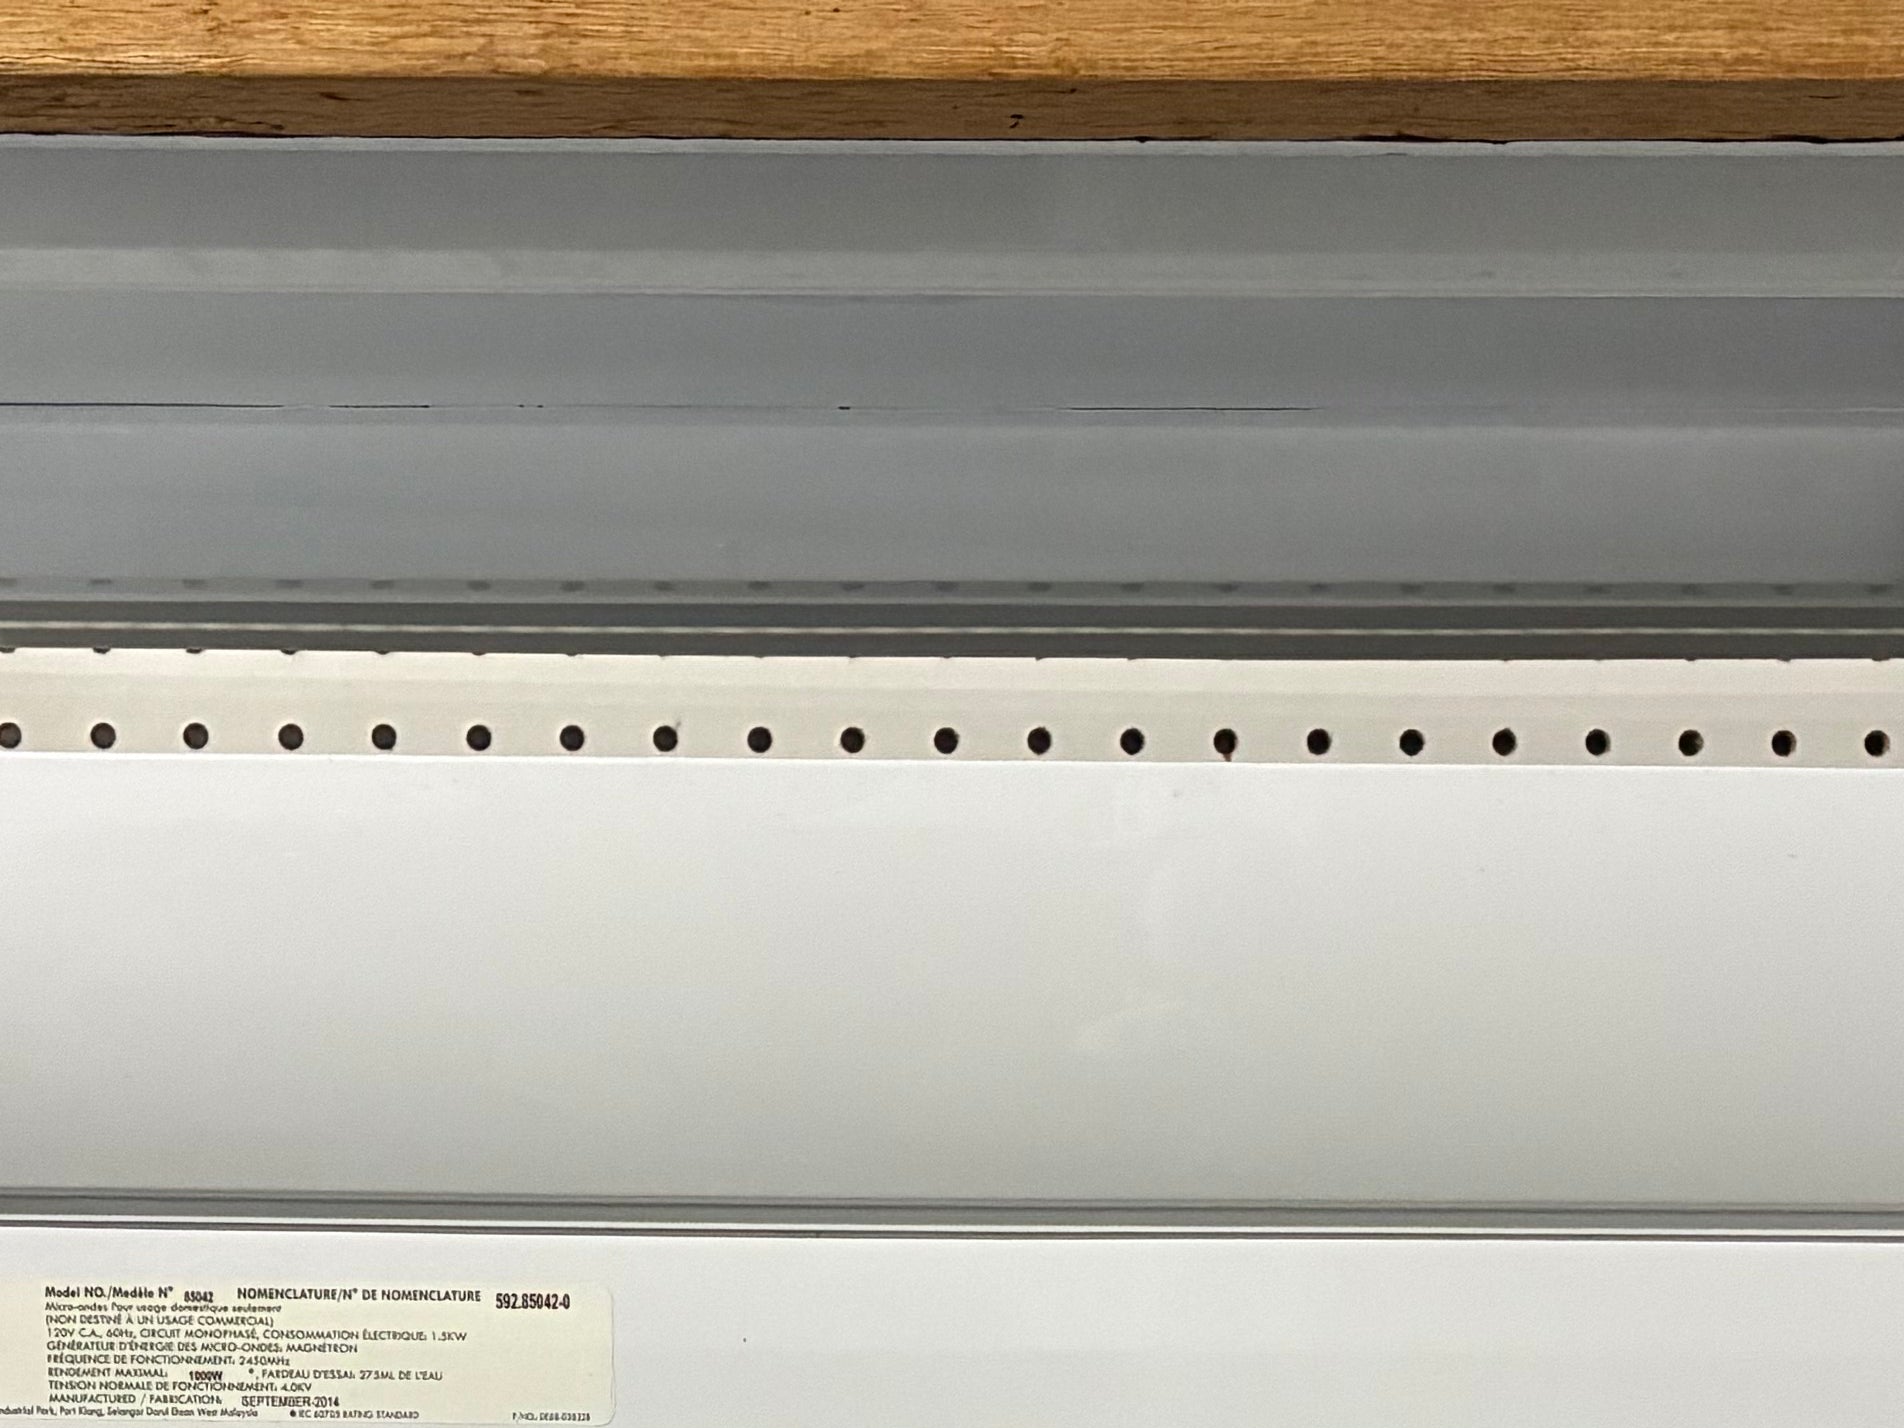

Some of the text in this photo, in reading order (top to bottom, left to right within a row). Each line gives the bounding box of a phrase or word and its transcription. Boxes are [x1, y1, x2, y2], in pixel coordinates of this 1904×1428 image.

[362, 1289, 377, 1300] DE
[382, 1290, 480, 1302] NOMENCLATURE
[496, 1293, 570, 1309] 592.85042-0
